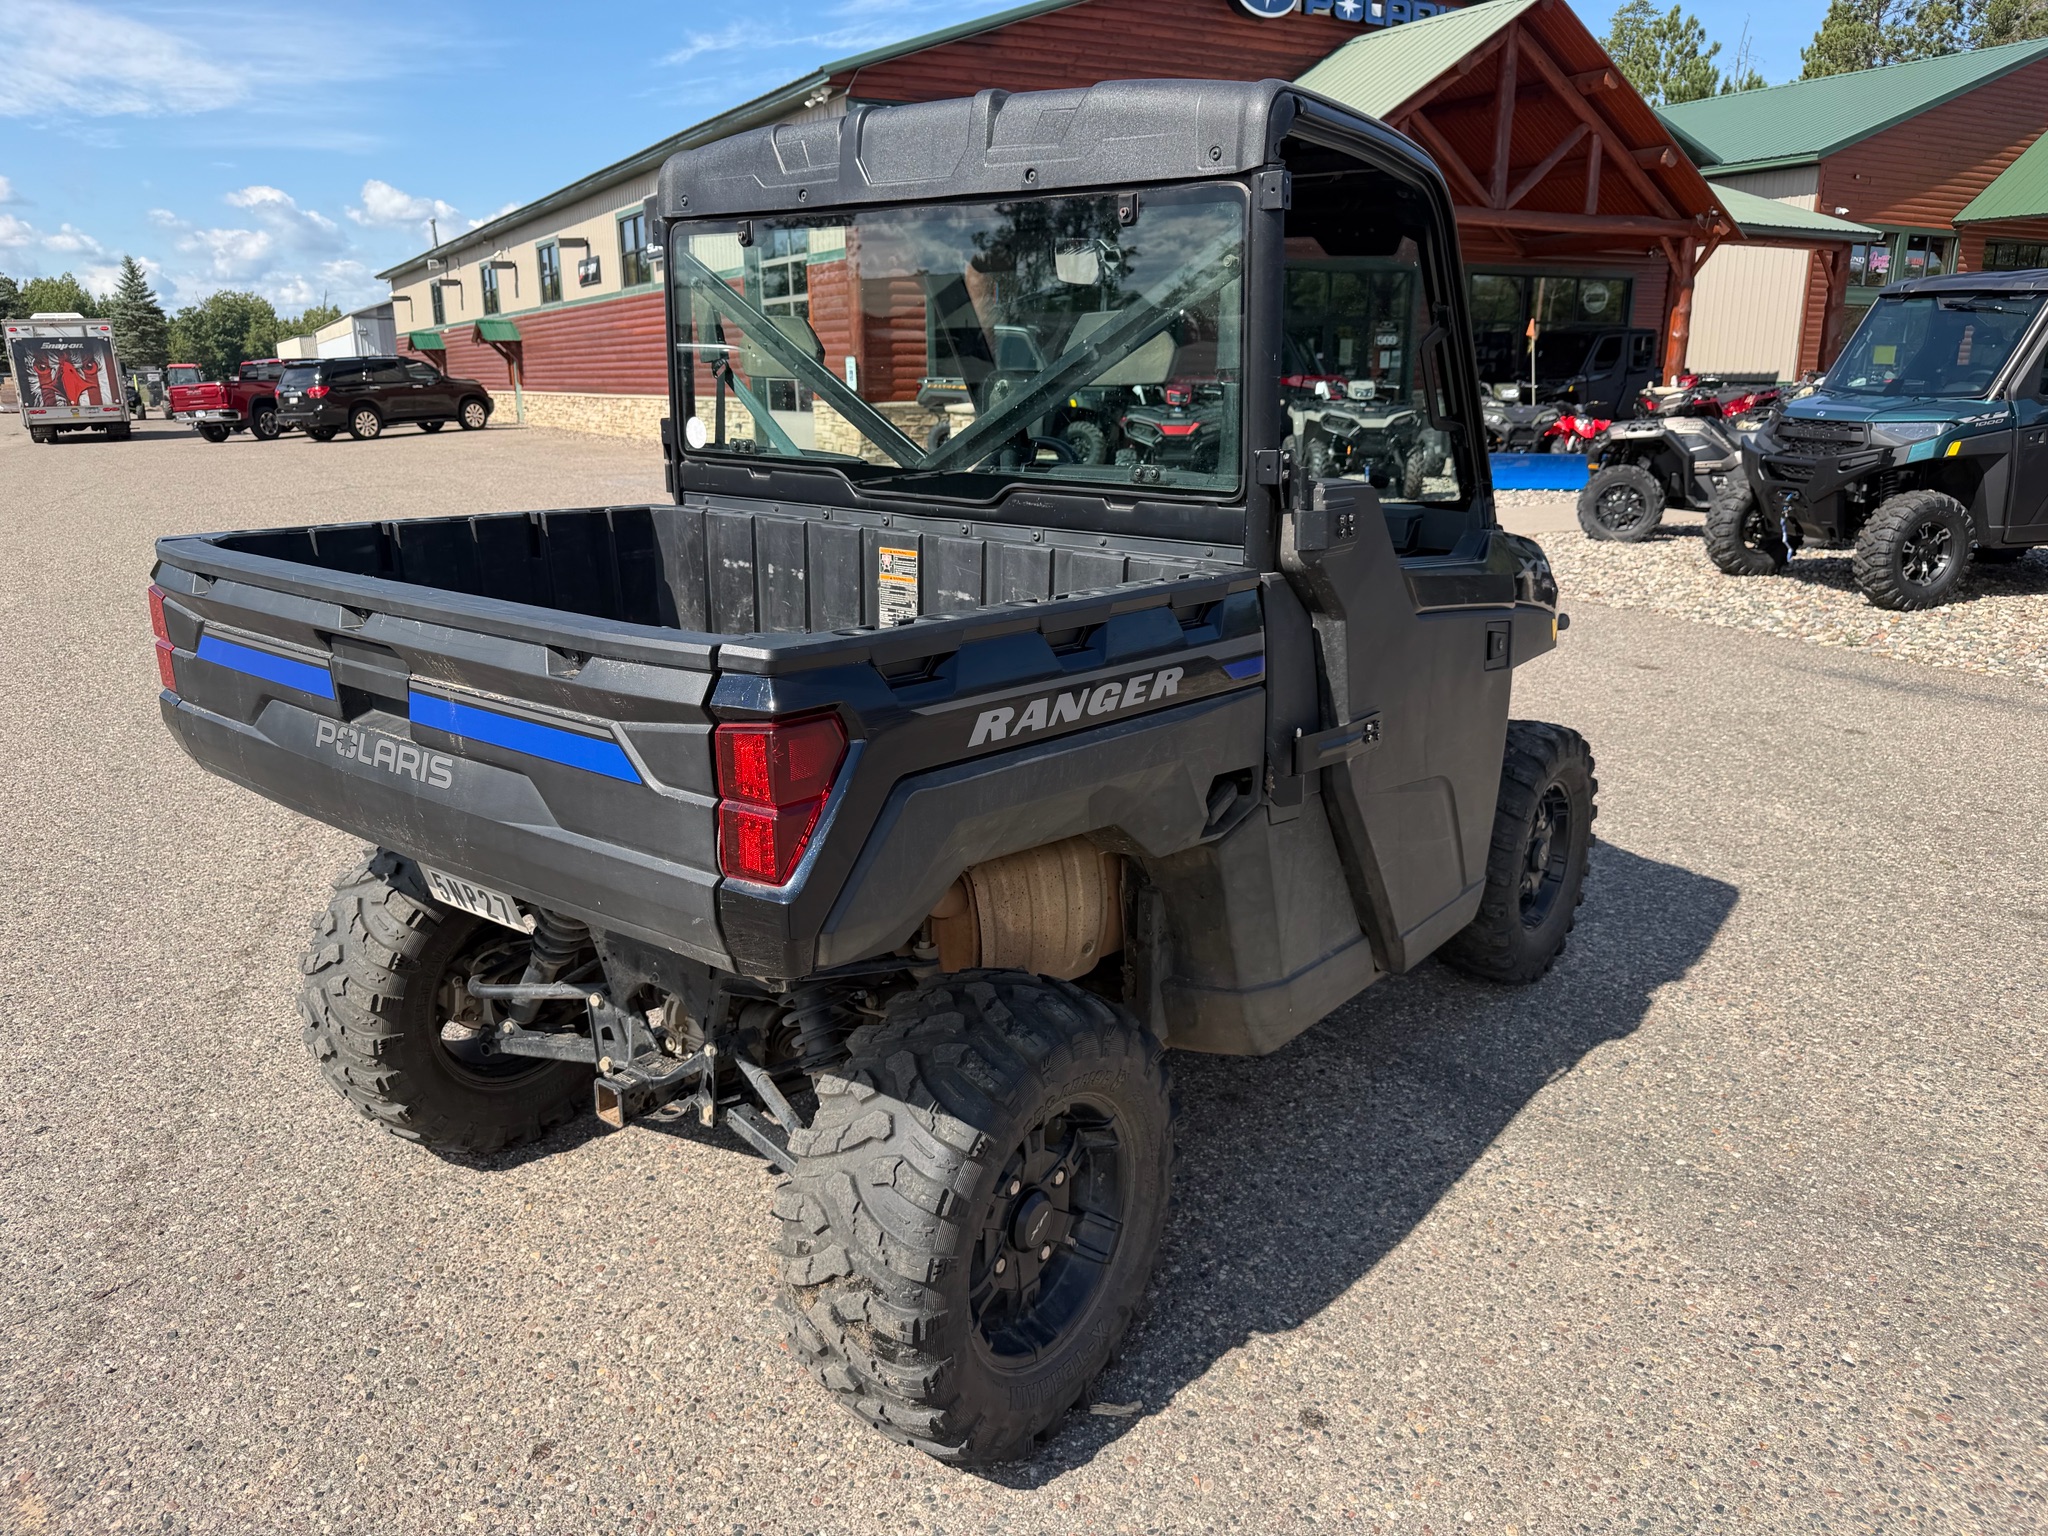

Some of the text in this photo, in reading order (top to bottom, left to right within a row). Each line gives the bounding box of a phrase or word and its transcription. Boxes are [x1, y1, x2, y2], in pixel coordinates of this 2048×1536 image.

[41, 342, 84, 350] Snap-on
[1975, 418, 2004, 428] 1000
[1515, 557, 1550, 580] XP
[967, 666, 1185, 748] RANGER
[315, 719, 454, 790] POLARIS
[430, 871, 512, 925] 5NP27
